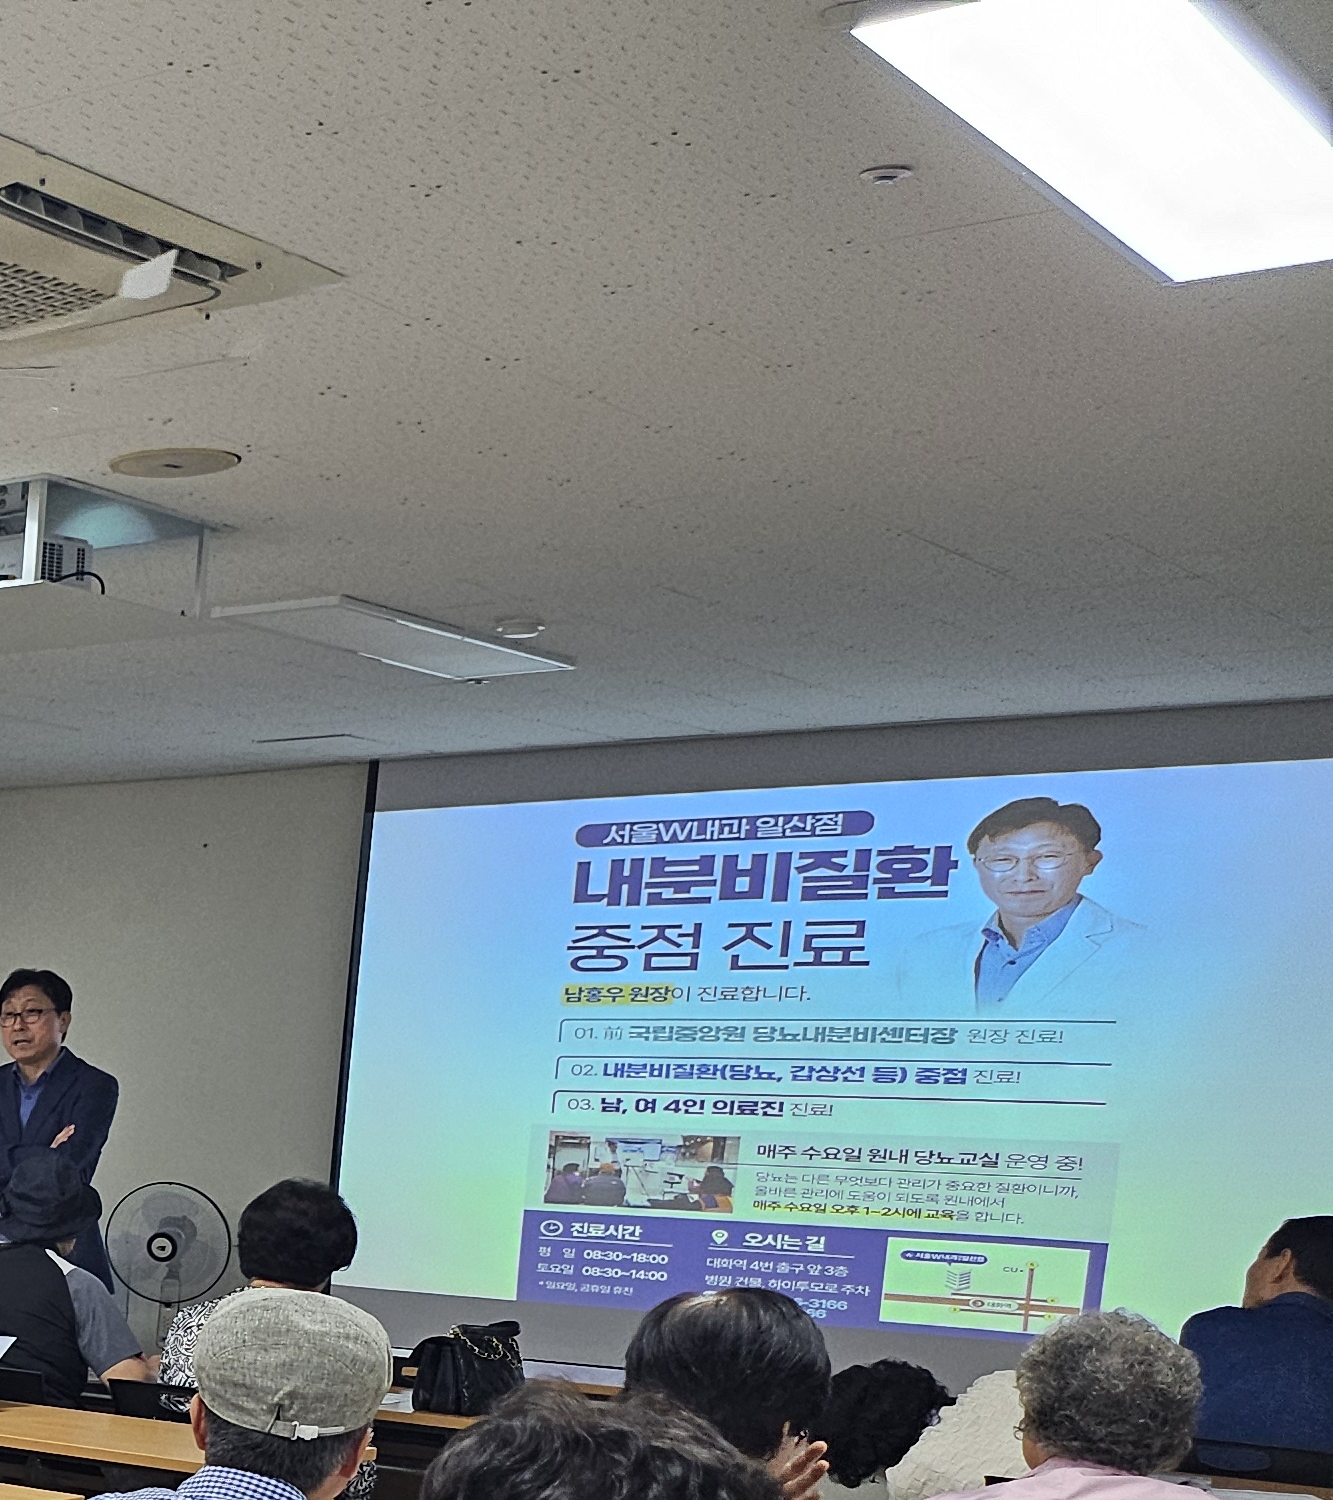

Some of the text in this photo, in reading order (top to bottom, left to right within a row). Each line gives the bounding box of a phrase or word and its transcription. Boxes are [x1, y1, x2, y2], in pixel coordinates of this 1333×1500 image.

[603, 813, 843, 846] 서울W내과 일산점
[572, 845, 958, 906] 내분비질환
[566, 919, 870, 971] 중점 진료
[564, 985, 811, 1003] 남홍우 원장이 진료합니다.
[574, 1028, 598, 1040] 01.
[752, 1026, 958, 1045] 당뇨내분비센터장
[967, 1028, 1010, 1045] 원장
[1015, 1029, 1064, 1045] 진료!
[571, 1064, 598, 1077] 02.
[790, 1065, 865, 1083] 갑상선
[872, 1066, 908, 1084] 등)
[915, 1068, 968, 1085] 중점
[973, 1070, 1021, 1084] 진료!
[567, 1097, 834, 1117] 03. 남, 여 4인 의료진 진료!
[757, 1144, 1083, 1171] 매주 수요일 원내 당뇨교실 운영 중!
[756, 1171, 798, 1185] 당뇨는
[802, 1174, 829, 1185] 다른
[835, 1175, 892, 1188] 무엇보다
[896, 1178, 941, 1190] 관리가
[945, 1181, 991, 1193] 중요한
[755, 1186, 1005, 1208] 올바른 관리에 도움이 되도록 원내에서
[752, 1200, 782, 1211] 매주
[784, 1202, 827, 1214] 수요일
[830, 1204, 860, 1215] 오후
[924, 1209, 969, 1221] 교육을
[975, 1211, 1024, 1224] 합니다.
[570, 1222, 643, 1240] 진료시간
[743, 1233, 826, 1252] 오시는 길
[749, 1261, 773, 1272] 4번
